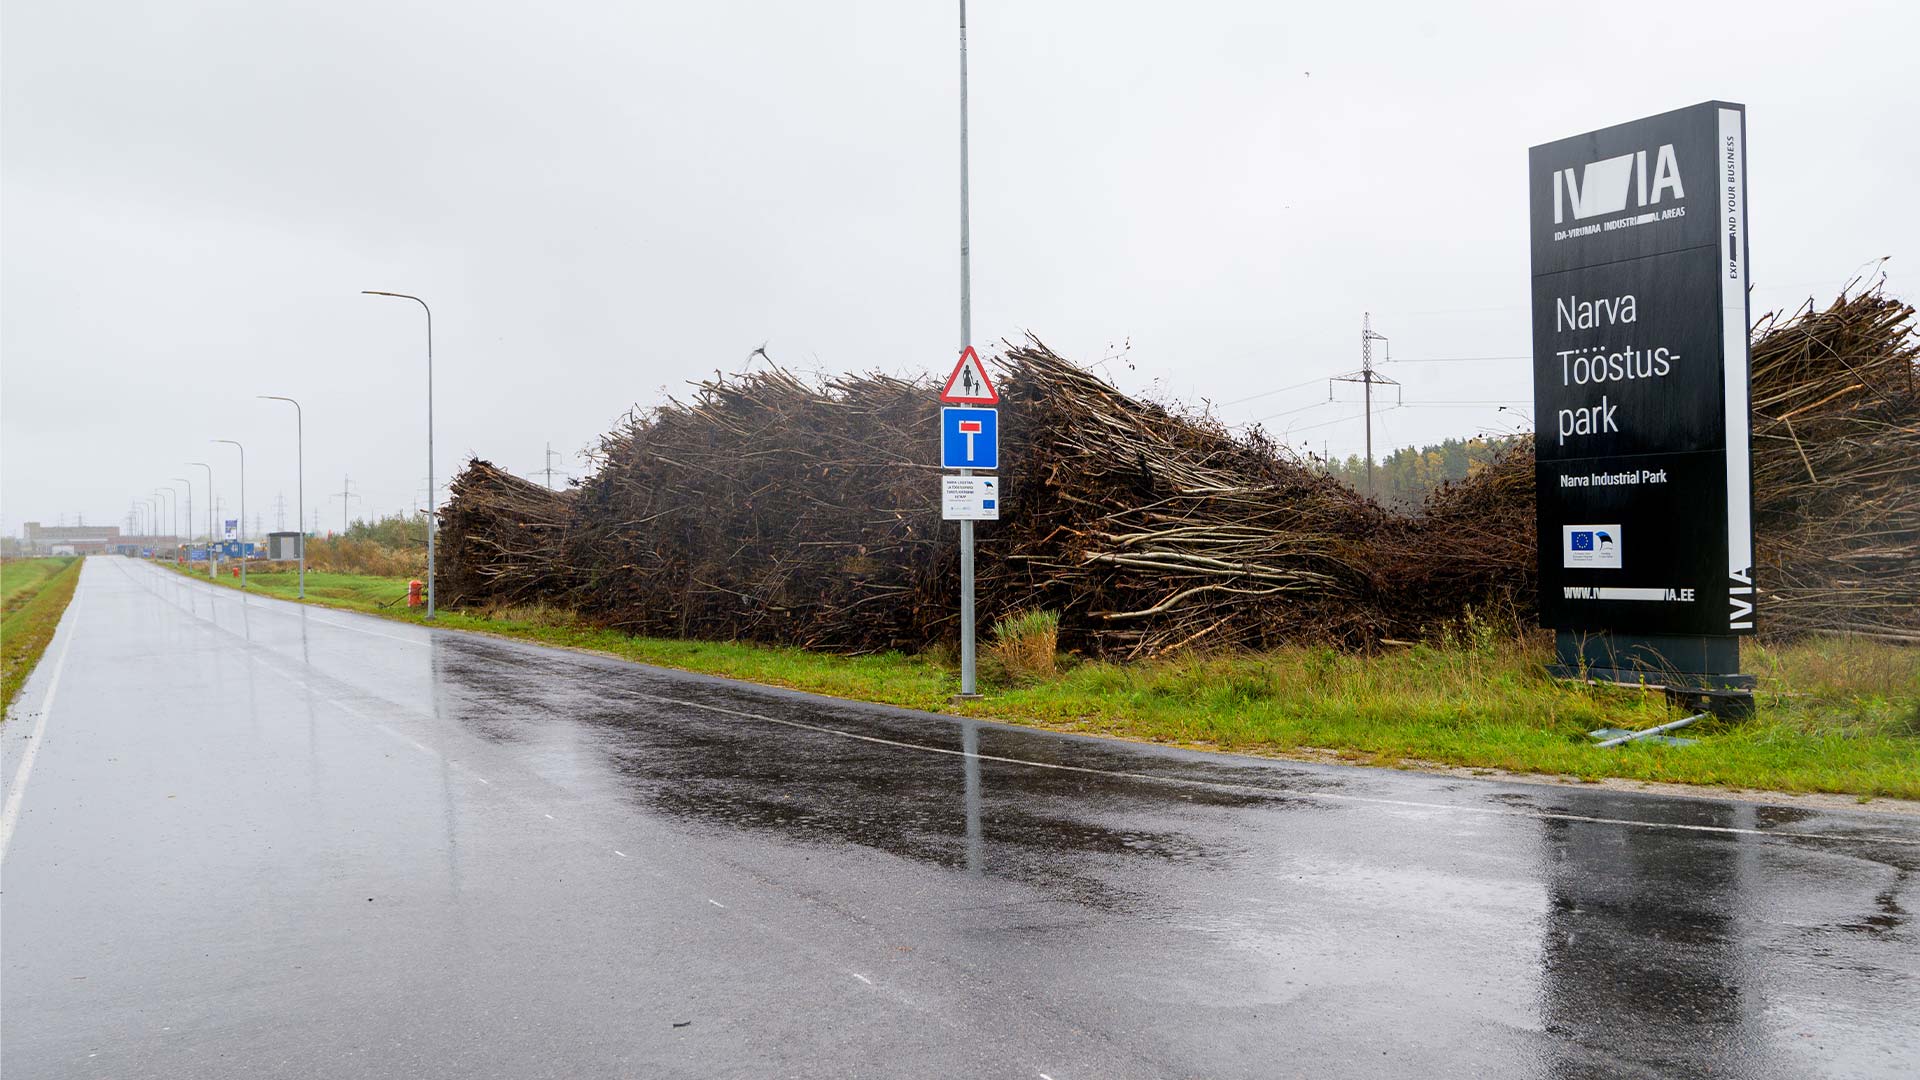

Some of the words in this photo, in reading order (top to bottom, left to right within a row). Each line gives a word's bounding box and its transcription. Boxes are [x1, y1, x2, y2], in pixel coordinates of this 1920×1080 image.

[1727, 135, 1735, 183] BUSINESS
[1728, 186, 1736, 215] YOUR
[1554, 224, 1602, 241] IDA-VIRUMAA
[1661, 206, 1686, 221] AREAS
[1557, 294, 1637, 333] Narva
[1556, 345, 1681, 386] Tööstus-
[1558, 395, 1619, 446] park
[1560, 474, 1589, 488] Narva
[1591, 470, 1640, 486] Industrial
[1642, 469, 1667, 484] Park
[1728, 566, 1753, 630] IVIA
